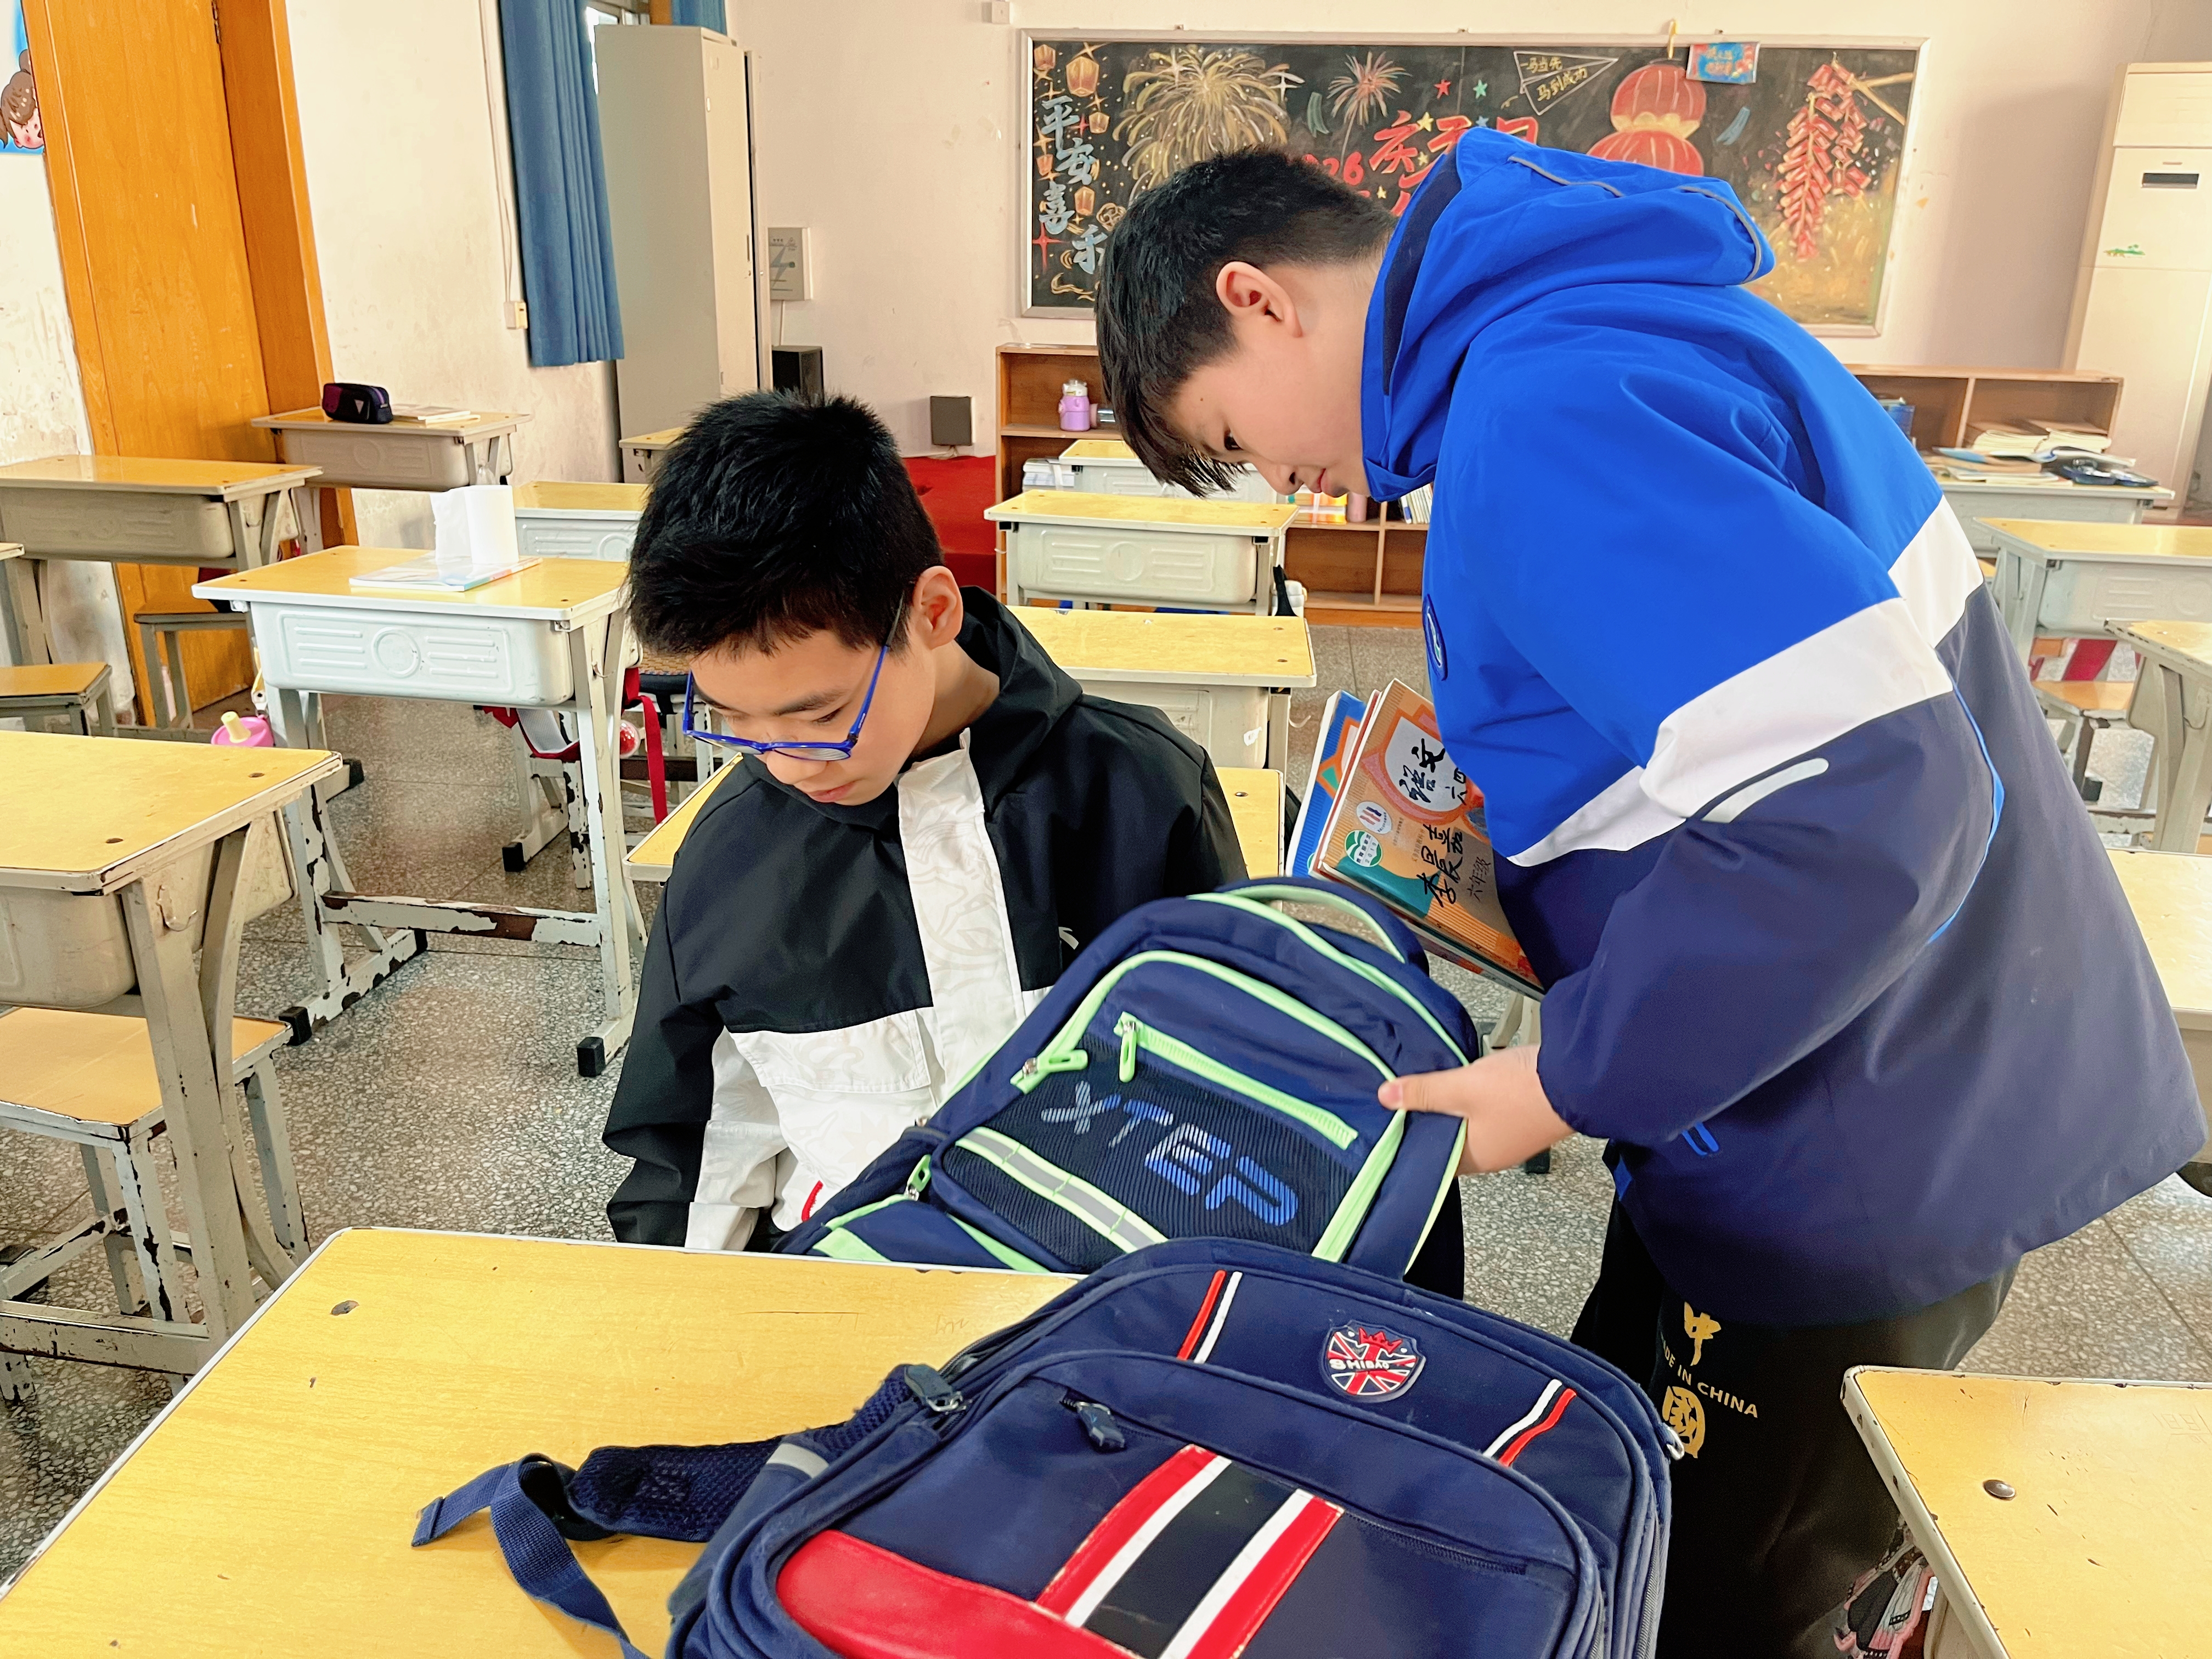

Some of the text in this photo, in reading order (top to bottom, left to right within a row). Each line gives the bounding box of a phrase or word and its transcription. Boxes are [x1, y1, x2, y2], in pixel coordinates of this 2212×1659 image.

[1520, 56, 1563, 74] 一马当先
[1536, 66, 1589, 101] 马到成功
[1399, 738, 1446, 803] 语文
[1417, 823, 1463, 908] 李晨嘉
[1466, 856, 1491, 903] 六年级
[1677, 1364, 1692, 1386] IN
[1697, 1381, 1759, 1419] CHINA
